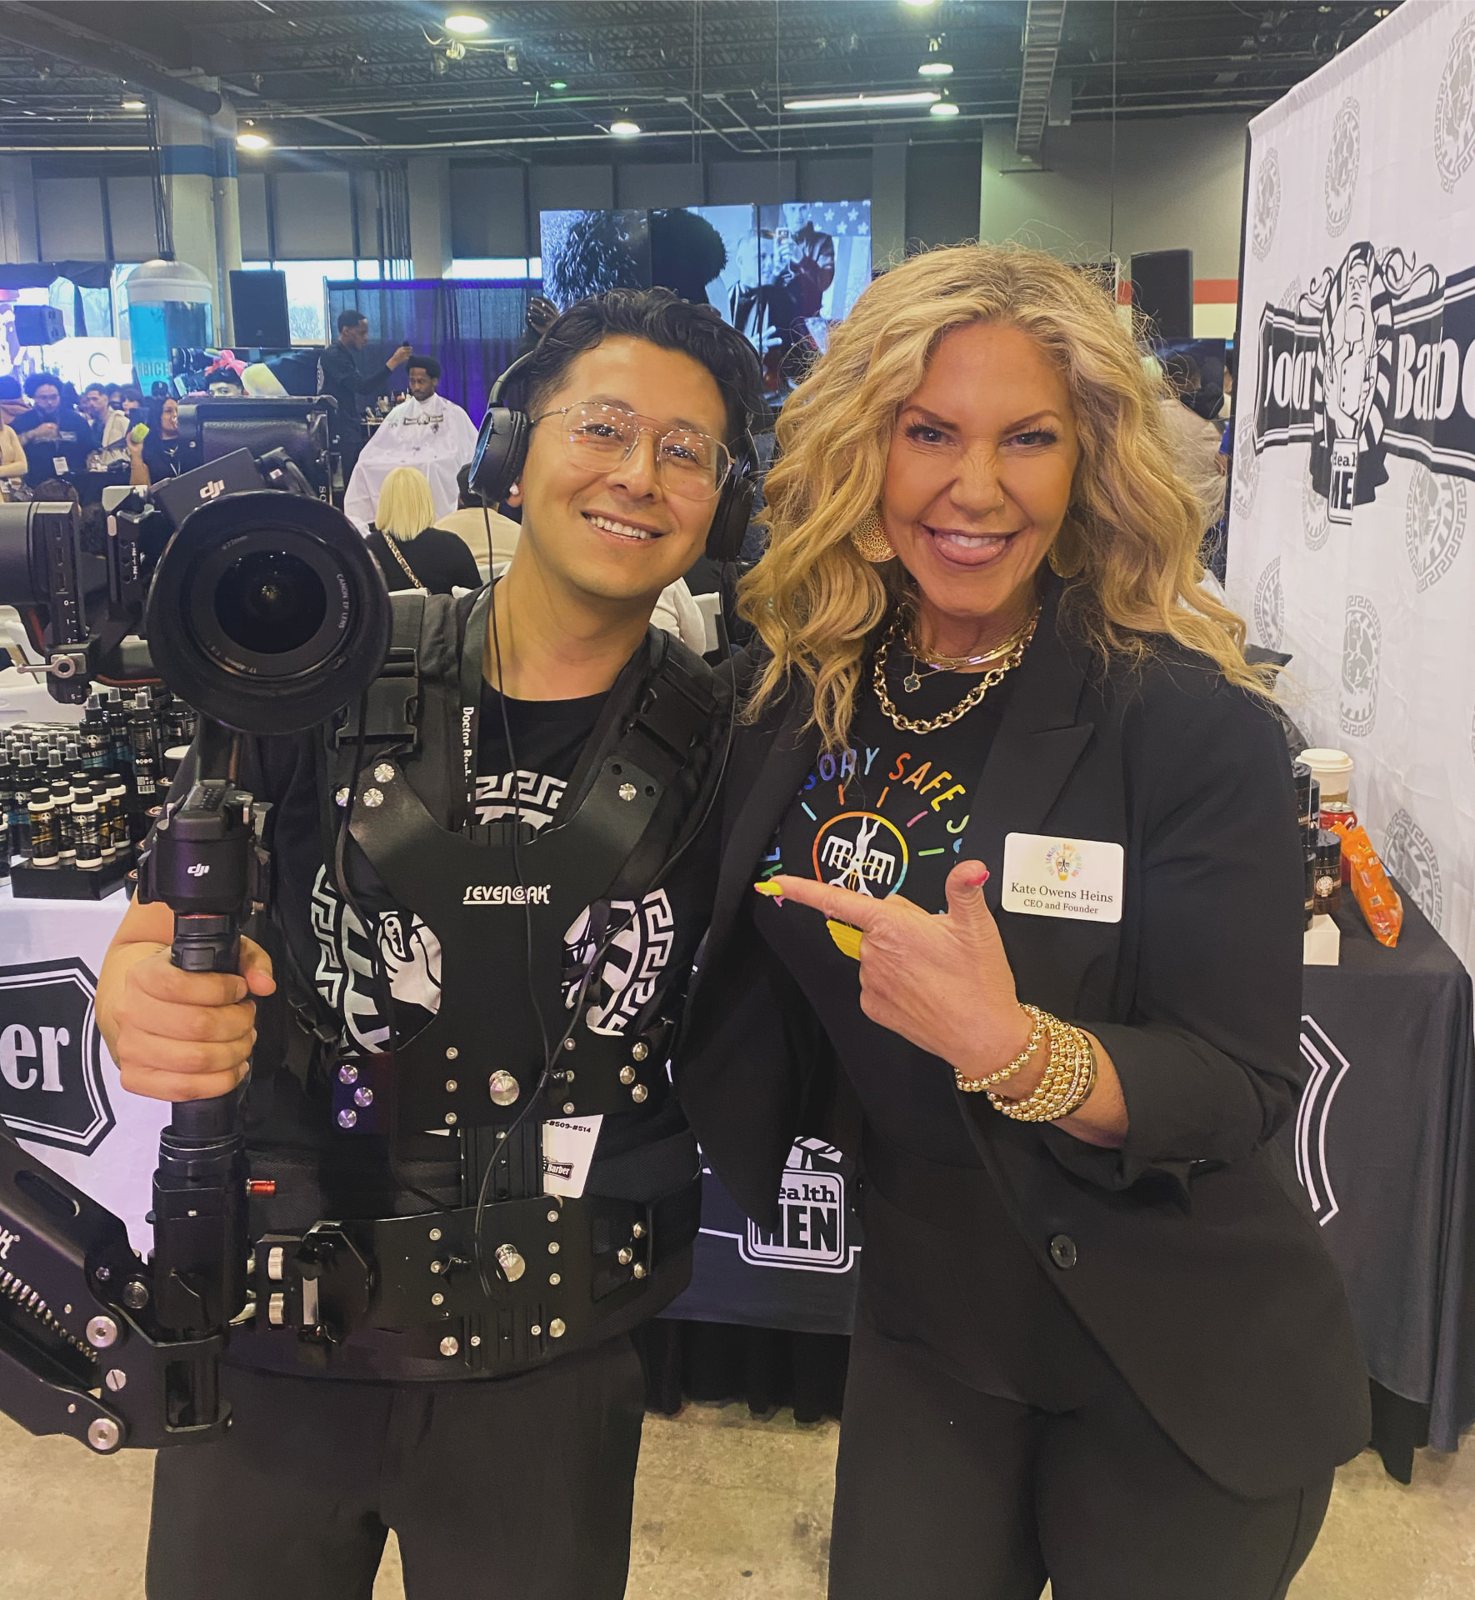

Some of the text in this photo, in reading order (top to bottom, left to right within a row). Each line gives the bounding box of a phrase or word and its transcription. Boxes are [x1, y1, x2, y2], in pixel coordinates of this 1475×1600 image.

[200, 479, 225, 499] dji
[888, 752, 966, 812] SAFE
[186, 862, 210, 878] dji
[1011, 882, 1114, 903] Kate Owens Heins
[1023, 899, 1099, 914] CEO and Founder
[547, 1164, 570, 1176] Barber
